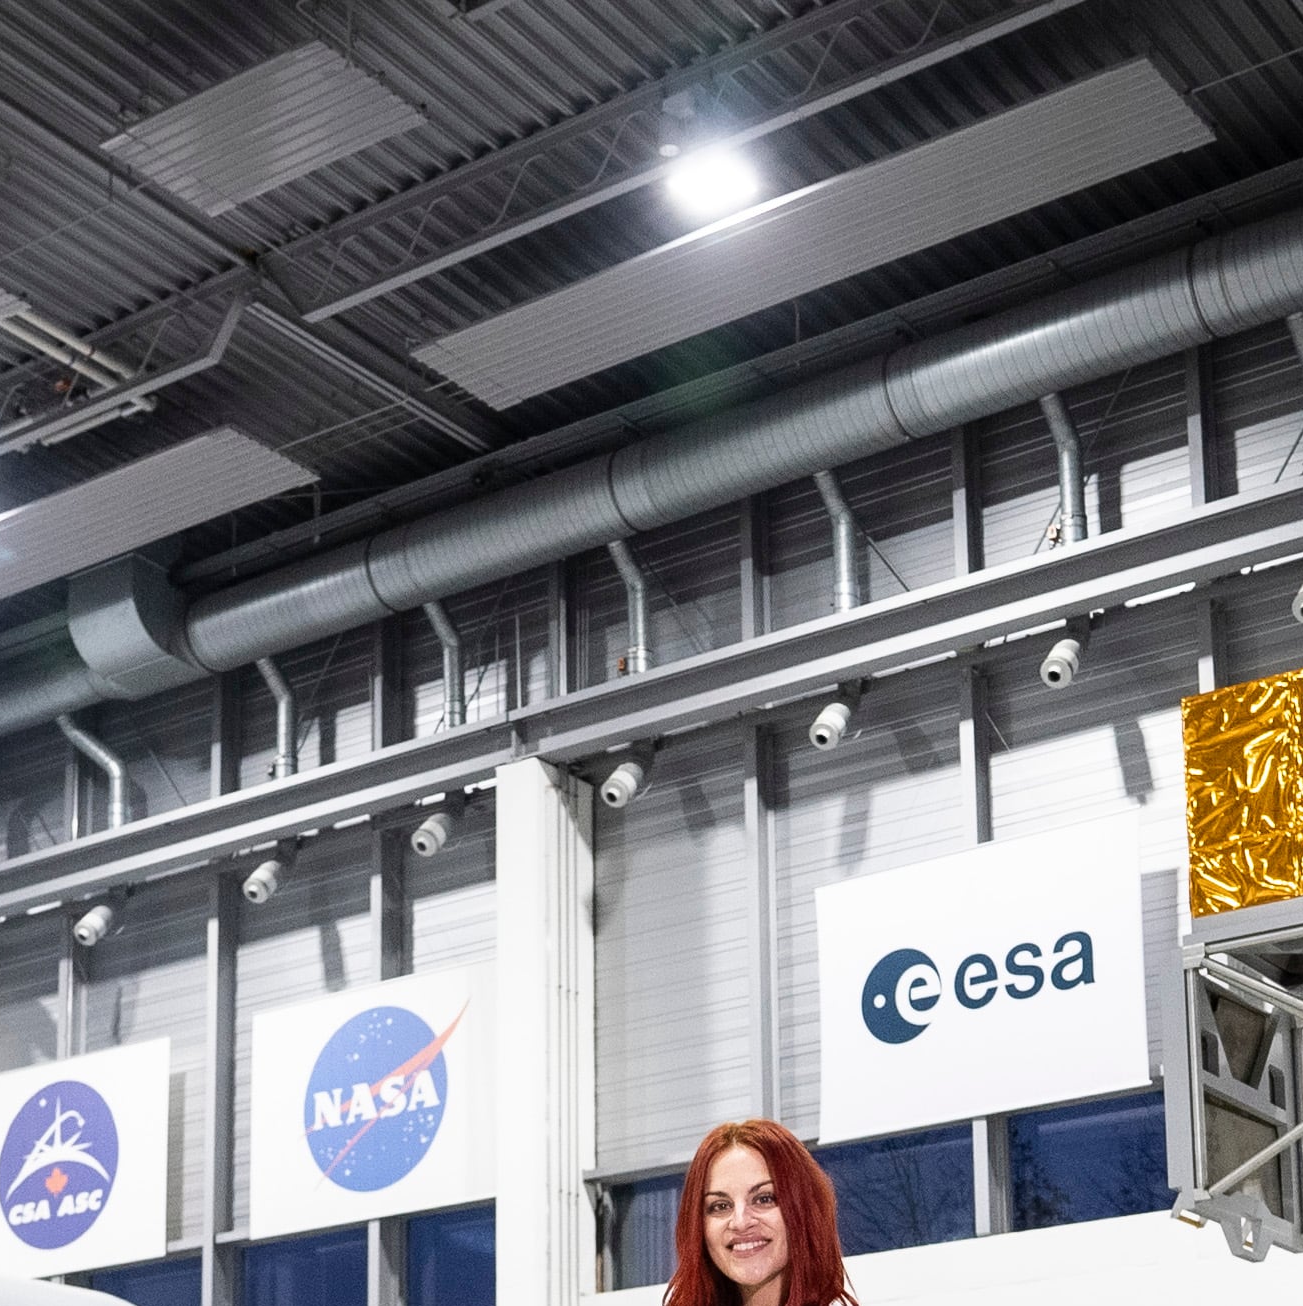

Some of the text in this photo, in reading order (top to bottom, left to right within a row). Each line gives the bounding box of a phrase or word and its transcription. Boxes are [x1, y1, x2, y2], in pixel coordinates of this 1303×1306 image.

[954, 930, 1096, 1010] esa
[313, 1070, 441, 1131] NASA
[8, 1188, 103, 1226] CSA ASC
